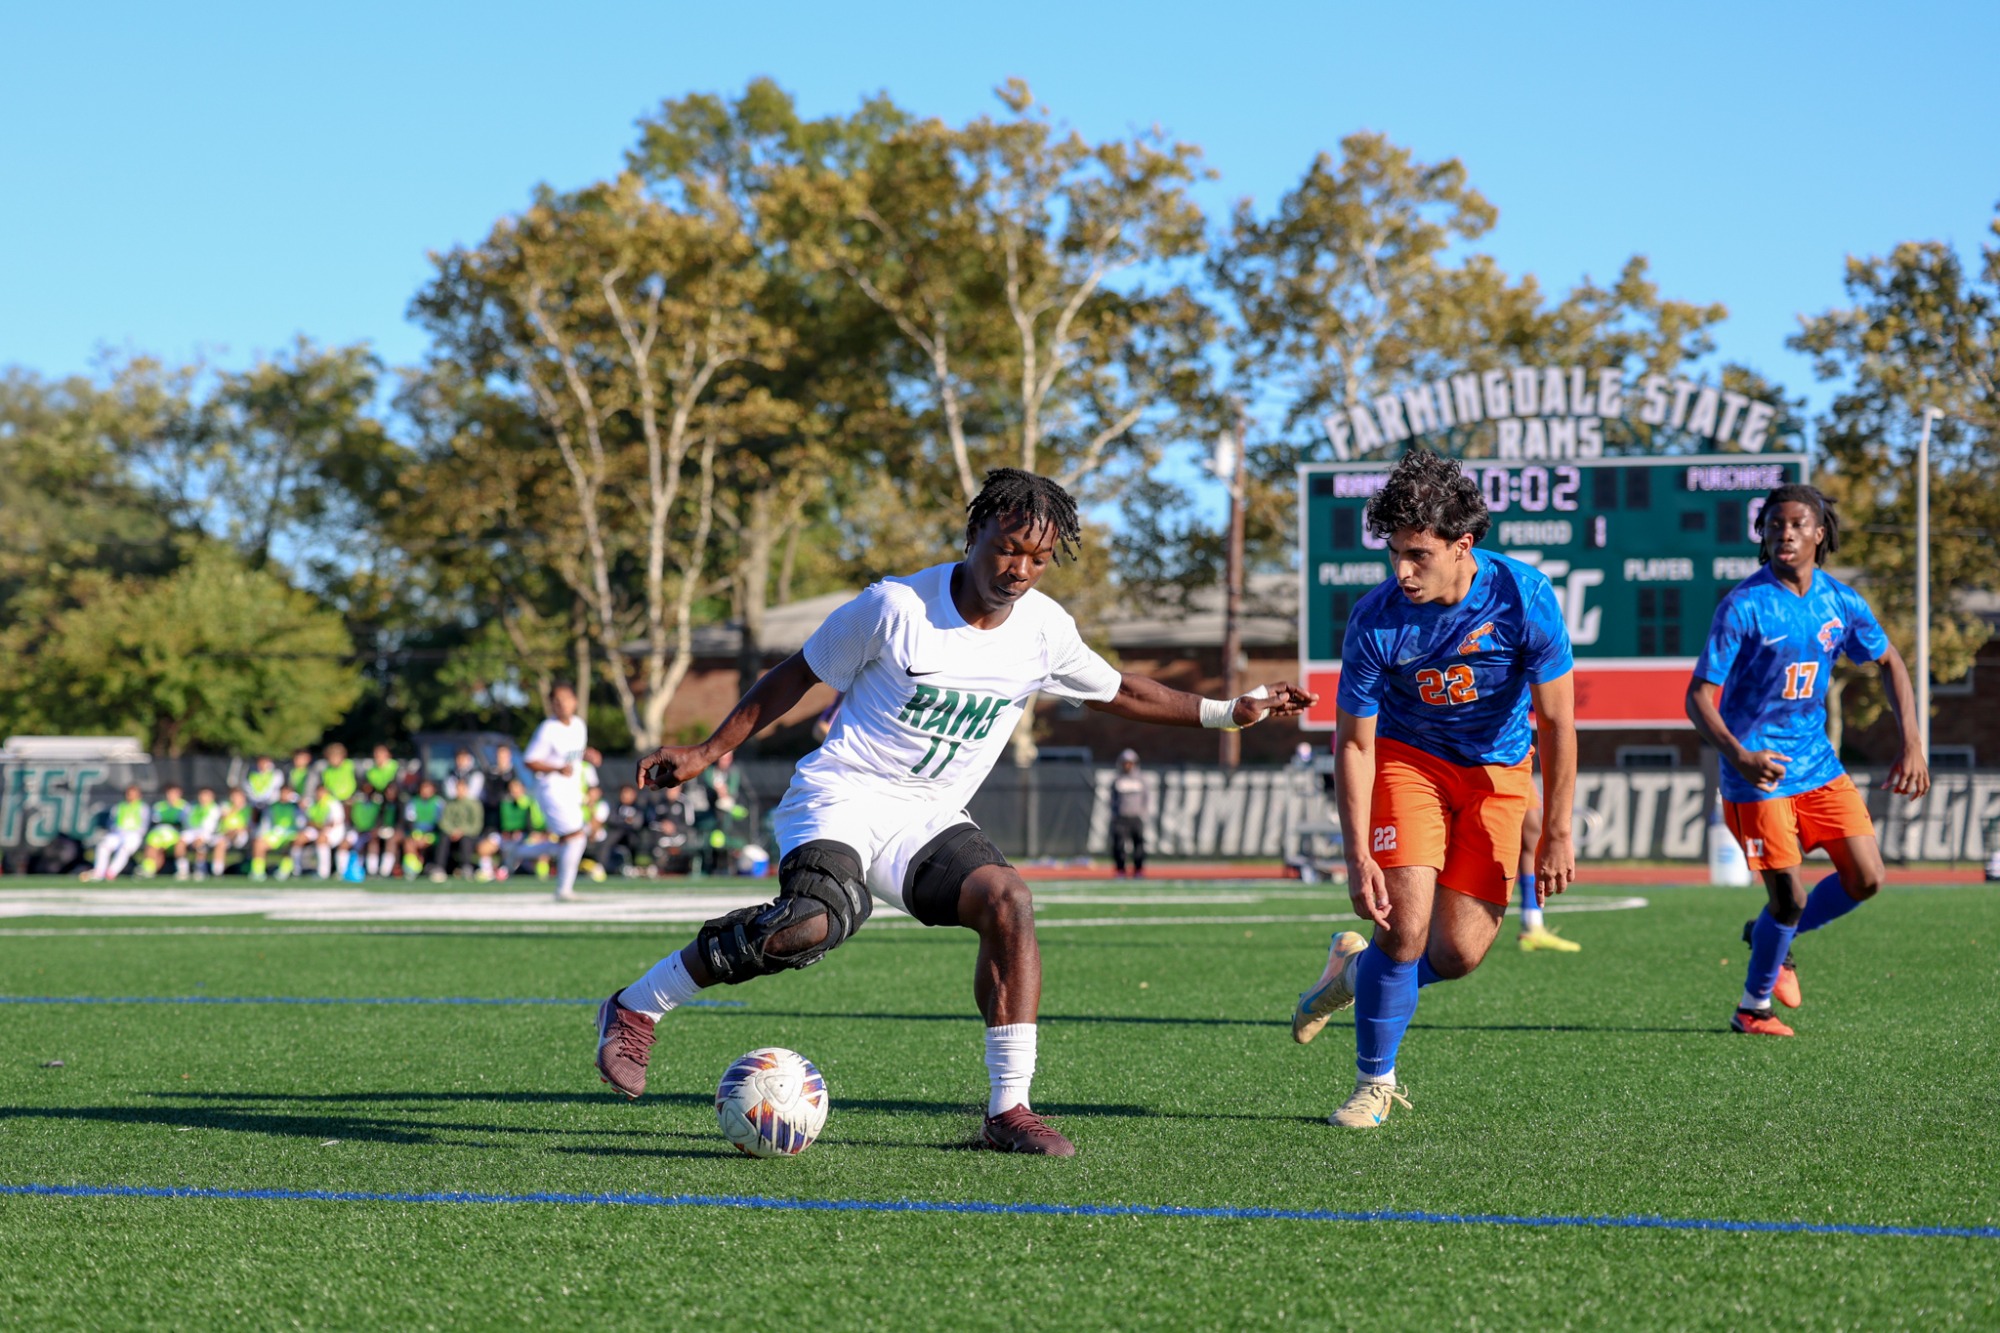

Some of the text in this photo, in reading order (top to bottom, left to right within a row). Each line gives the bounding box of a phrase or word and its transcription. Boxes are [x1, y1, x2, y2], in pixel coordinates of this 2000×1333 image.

[1324, 365, 1776, 461] FARMINGDALE STATE
[1497, 417, 1603, 459] RAMS
[1462, 465, 1580, 512] 0:02
[1498, 520, 1573, 545] PERIOD
[1595, 515, 1607, 547] 1
[1318, 562, 1386, 585] PLAYER
[1624, 558, 1694, 581] PLAYER
[1415, 663, 1479, 706] 22
[1782, 662, 1819, 700] 17
[898, 684, 1011, 740] RAMS
[910, 736, 961, 779] 11
[1, 764, 108, 848] FSC
[1373, 825, 1397, 852] 22
[1745, 838, 1764, 857] 17
